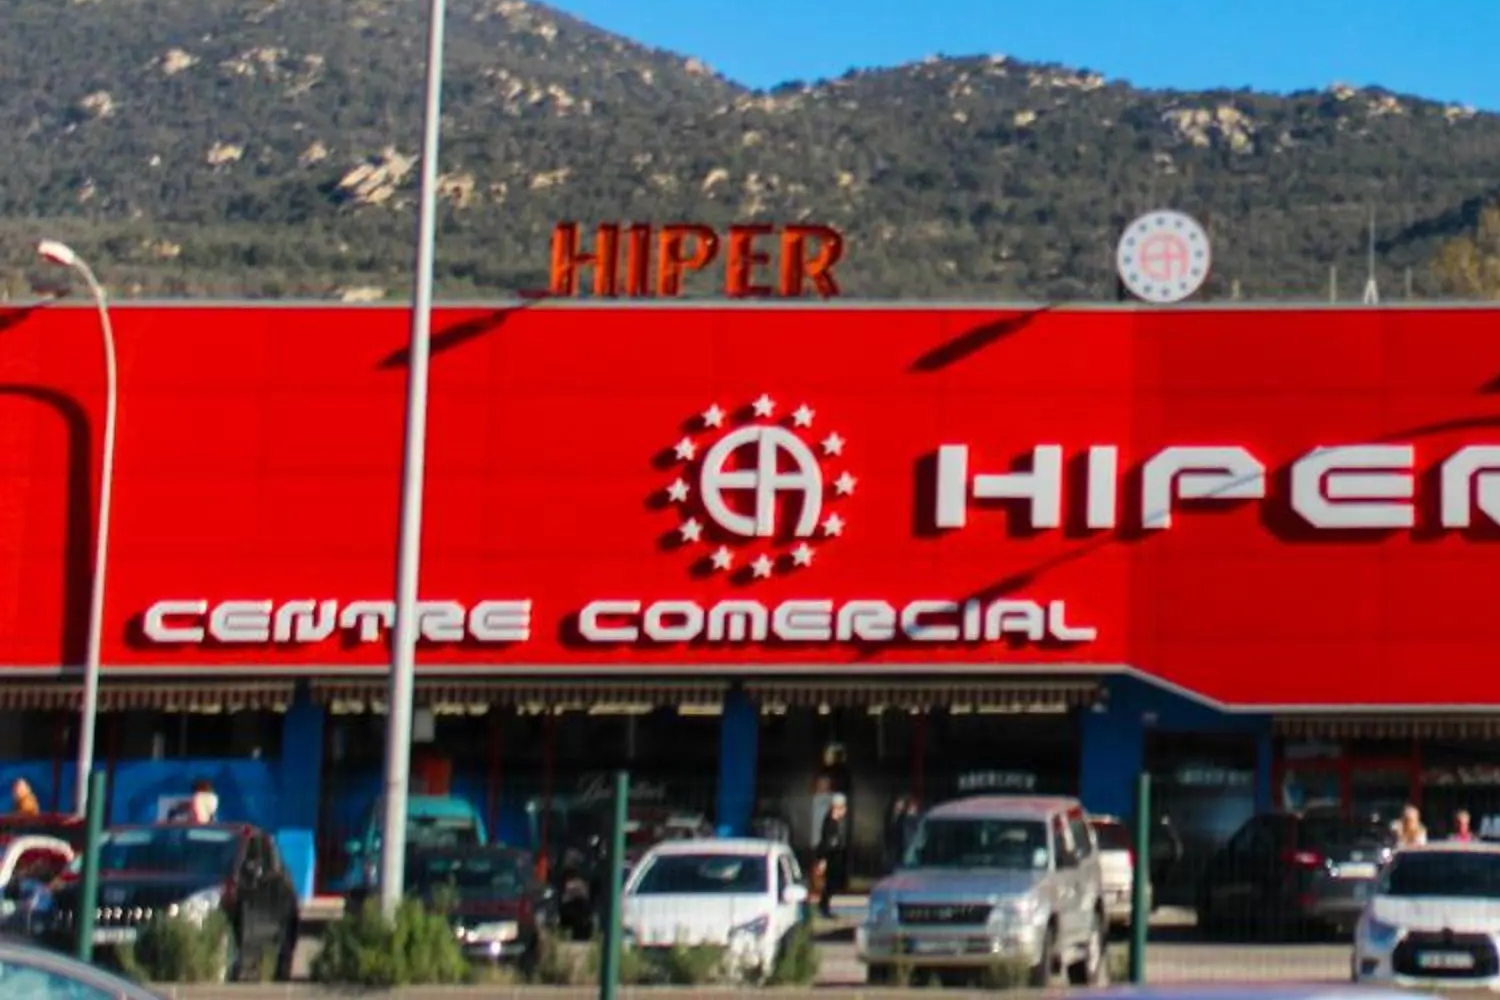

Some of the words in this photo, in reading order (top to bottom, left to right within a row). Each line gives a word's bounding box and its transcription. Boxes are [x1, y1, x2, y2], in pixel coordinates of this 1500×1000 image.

[549, 222, 844, 298] HIPER
[143, 599, 531, 643] CENTRE
[577, 599, 1097, 642] COMERCIAL
